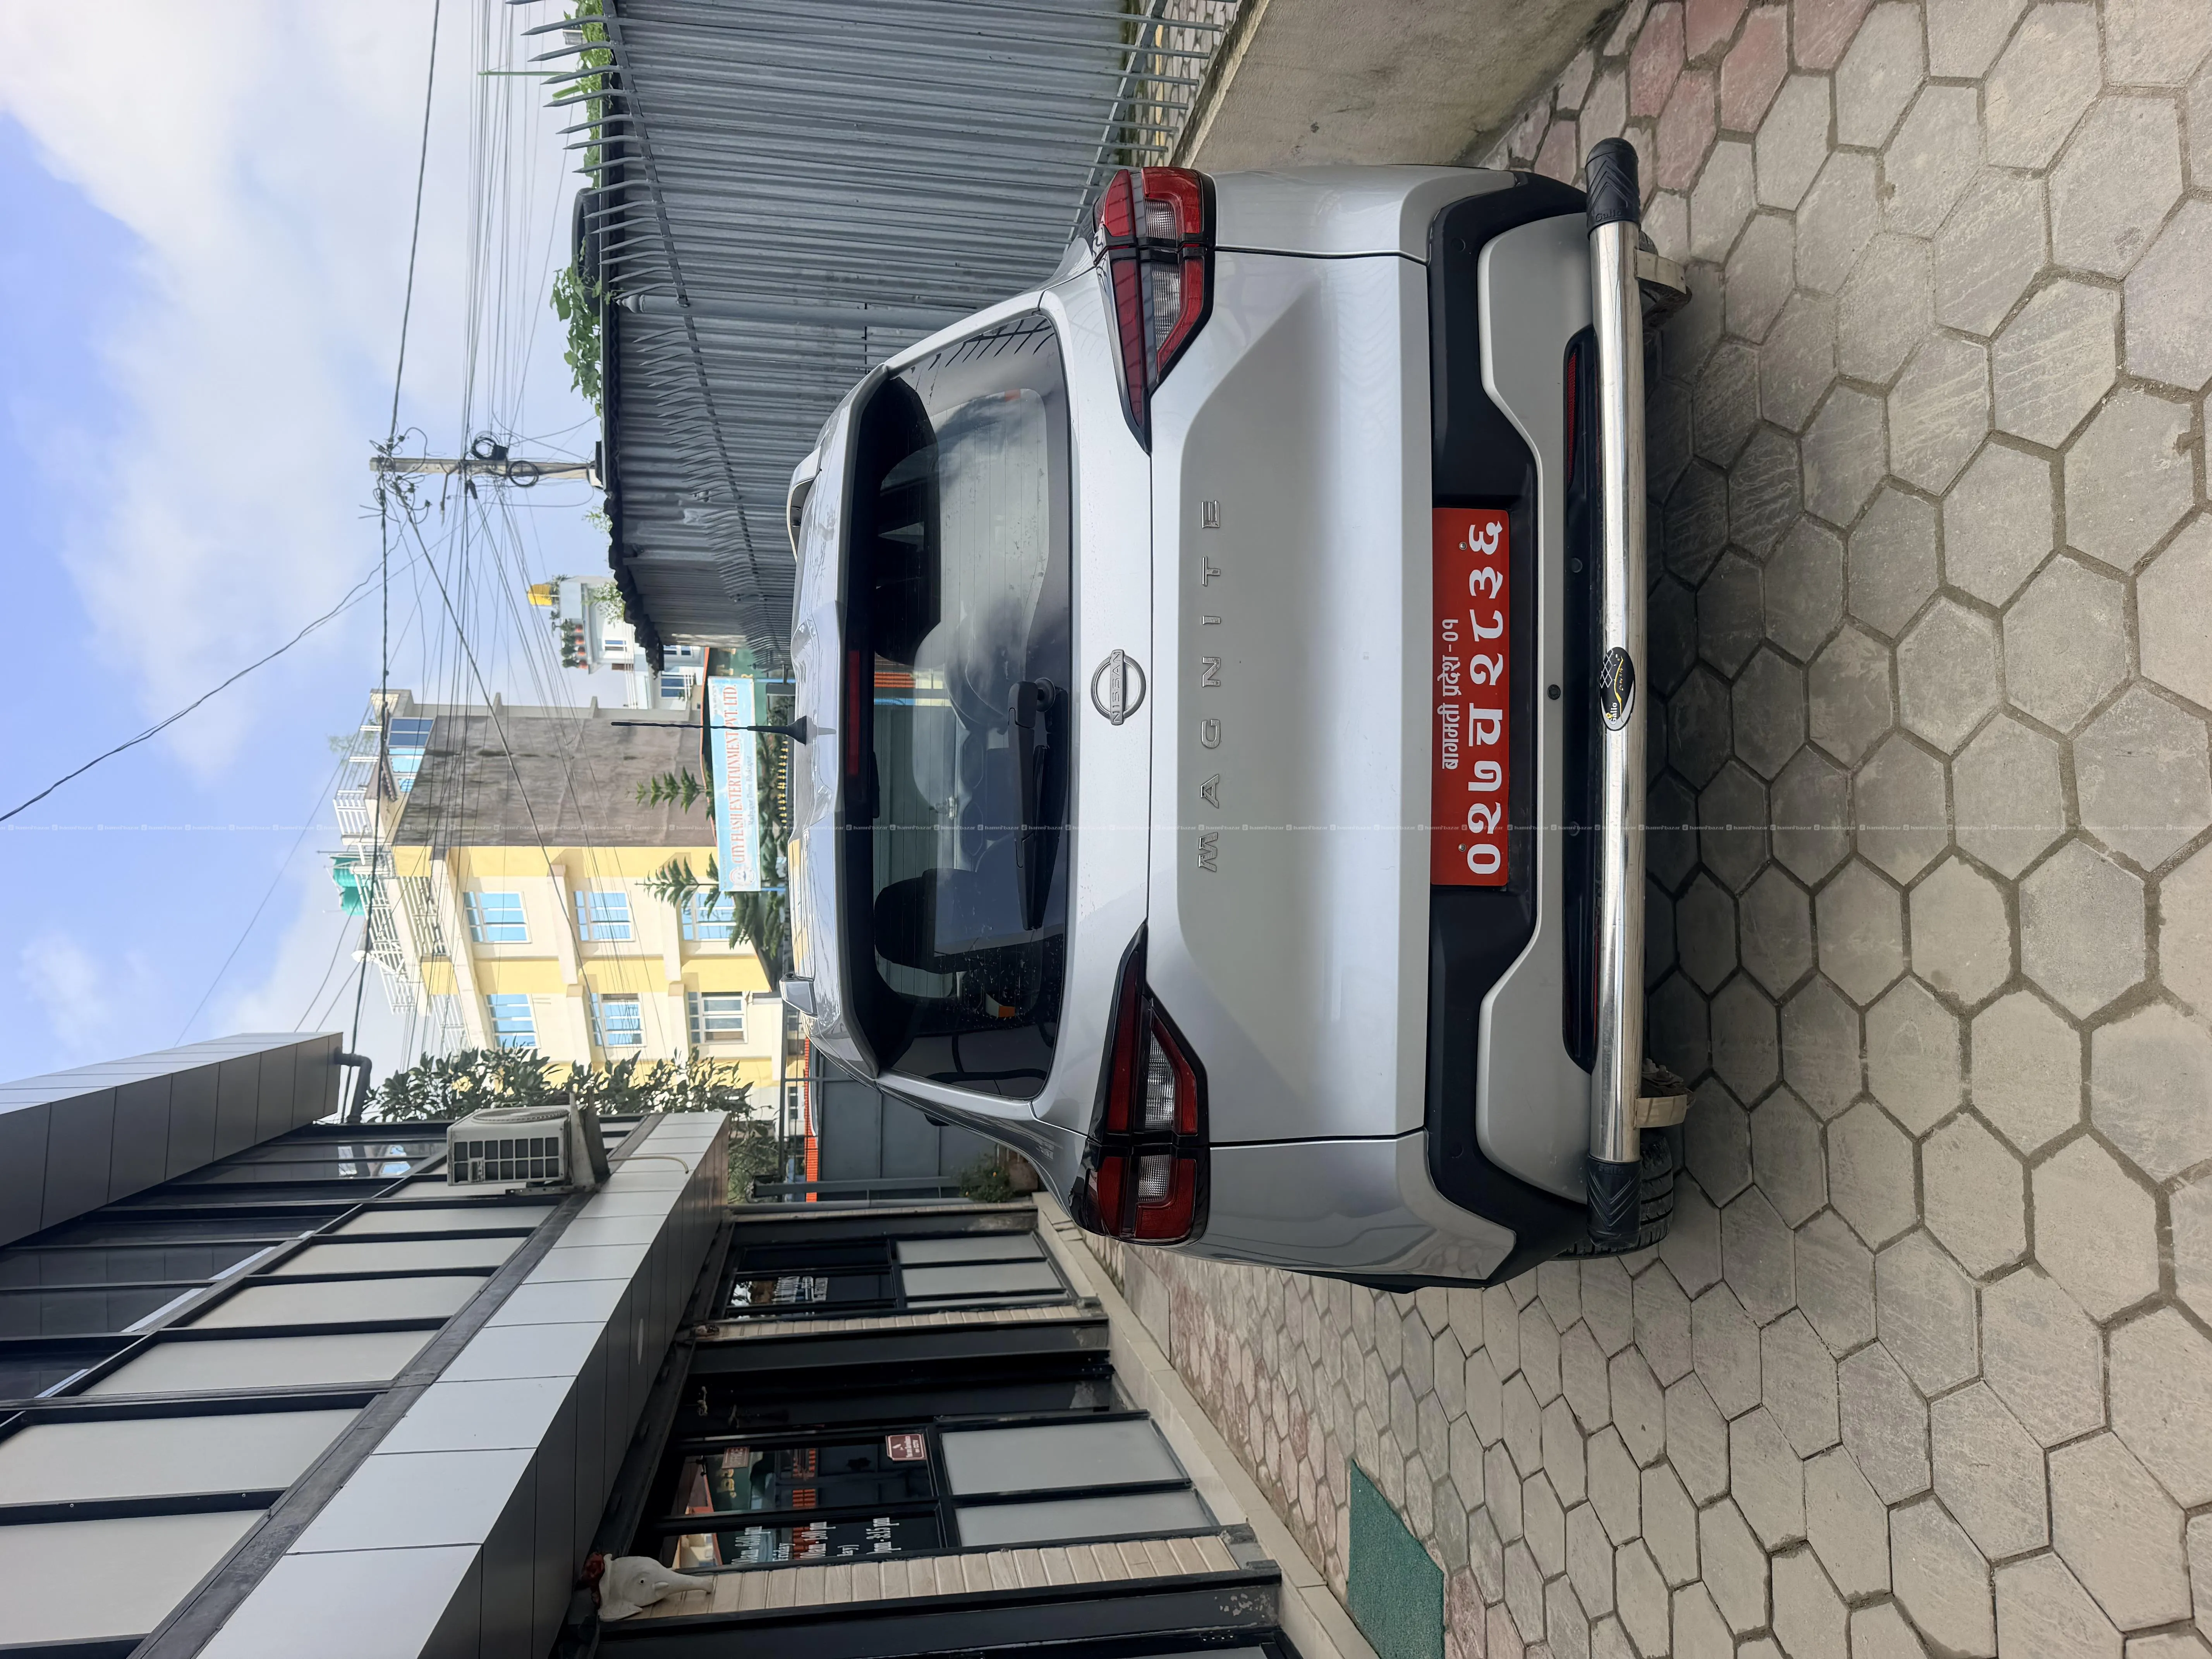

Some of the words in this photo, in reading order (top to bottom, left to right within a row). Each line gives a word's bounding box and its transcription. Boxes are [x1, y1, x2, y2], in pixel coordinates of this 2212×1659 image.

[723, 684, 737, 706] LTD.
[1111, 651, 1122, 723] NISSAN
[1197, 500, 1221, 872] MAGNITE
[1437, 702, 1460, 770] बागमती
[725, 731, 742, 811] ENTERTAINMENT
[730, 813, 744, 841] FLASH
[731, 843, 745, 864] CITY
